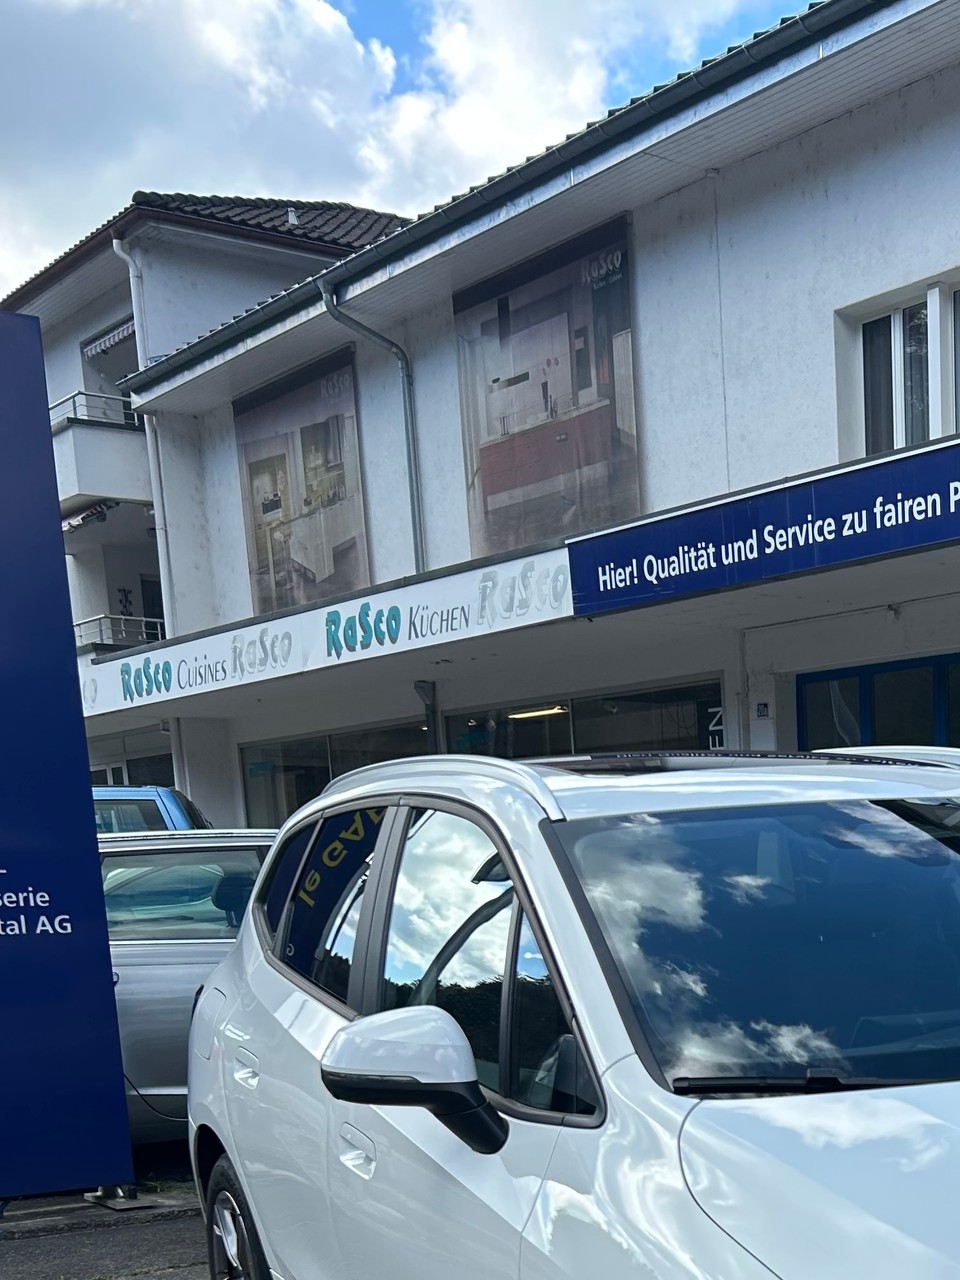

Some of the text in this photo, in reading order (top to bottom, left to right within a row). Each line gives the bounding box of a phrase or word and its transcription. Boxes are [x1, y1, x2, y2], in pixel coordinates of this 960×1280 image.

[598, 558, 639, 592] Hier!
[643, 540, 717, 583] Qualität
[721, 528, 758, 566] und
[763, 513, 836, 554] Service
[842, 508, 868, 535] zu
[874, 492, 942, 528] fairen
[325, 601, 401, 660] RaSco
[120, 656, 173, 703] RaSco
[36, 914, 73, 934] AG
